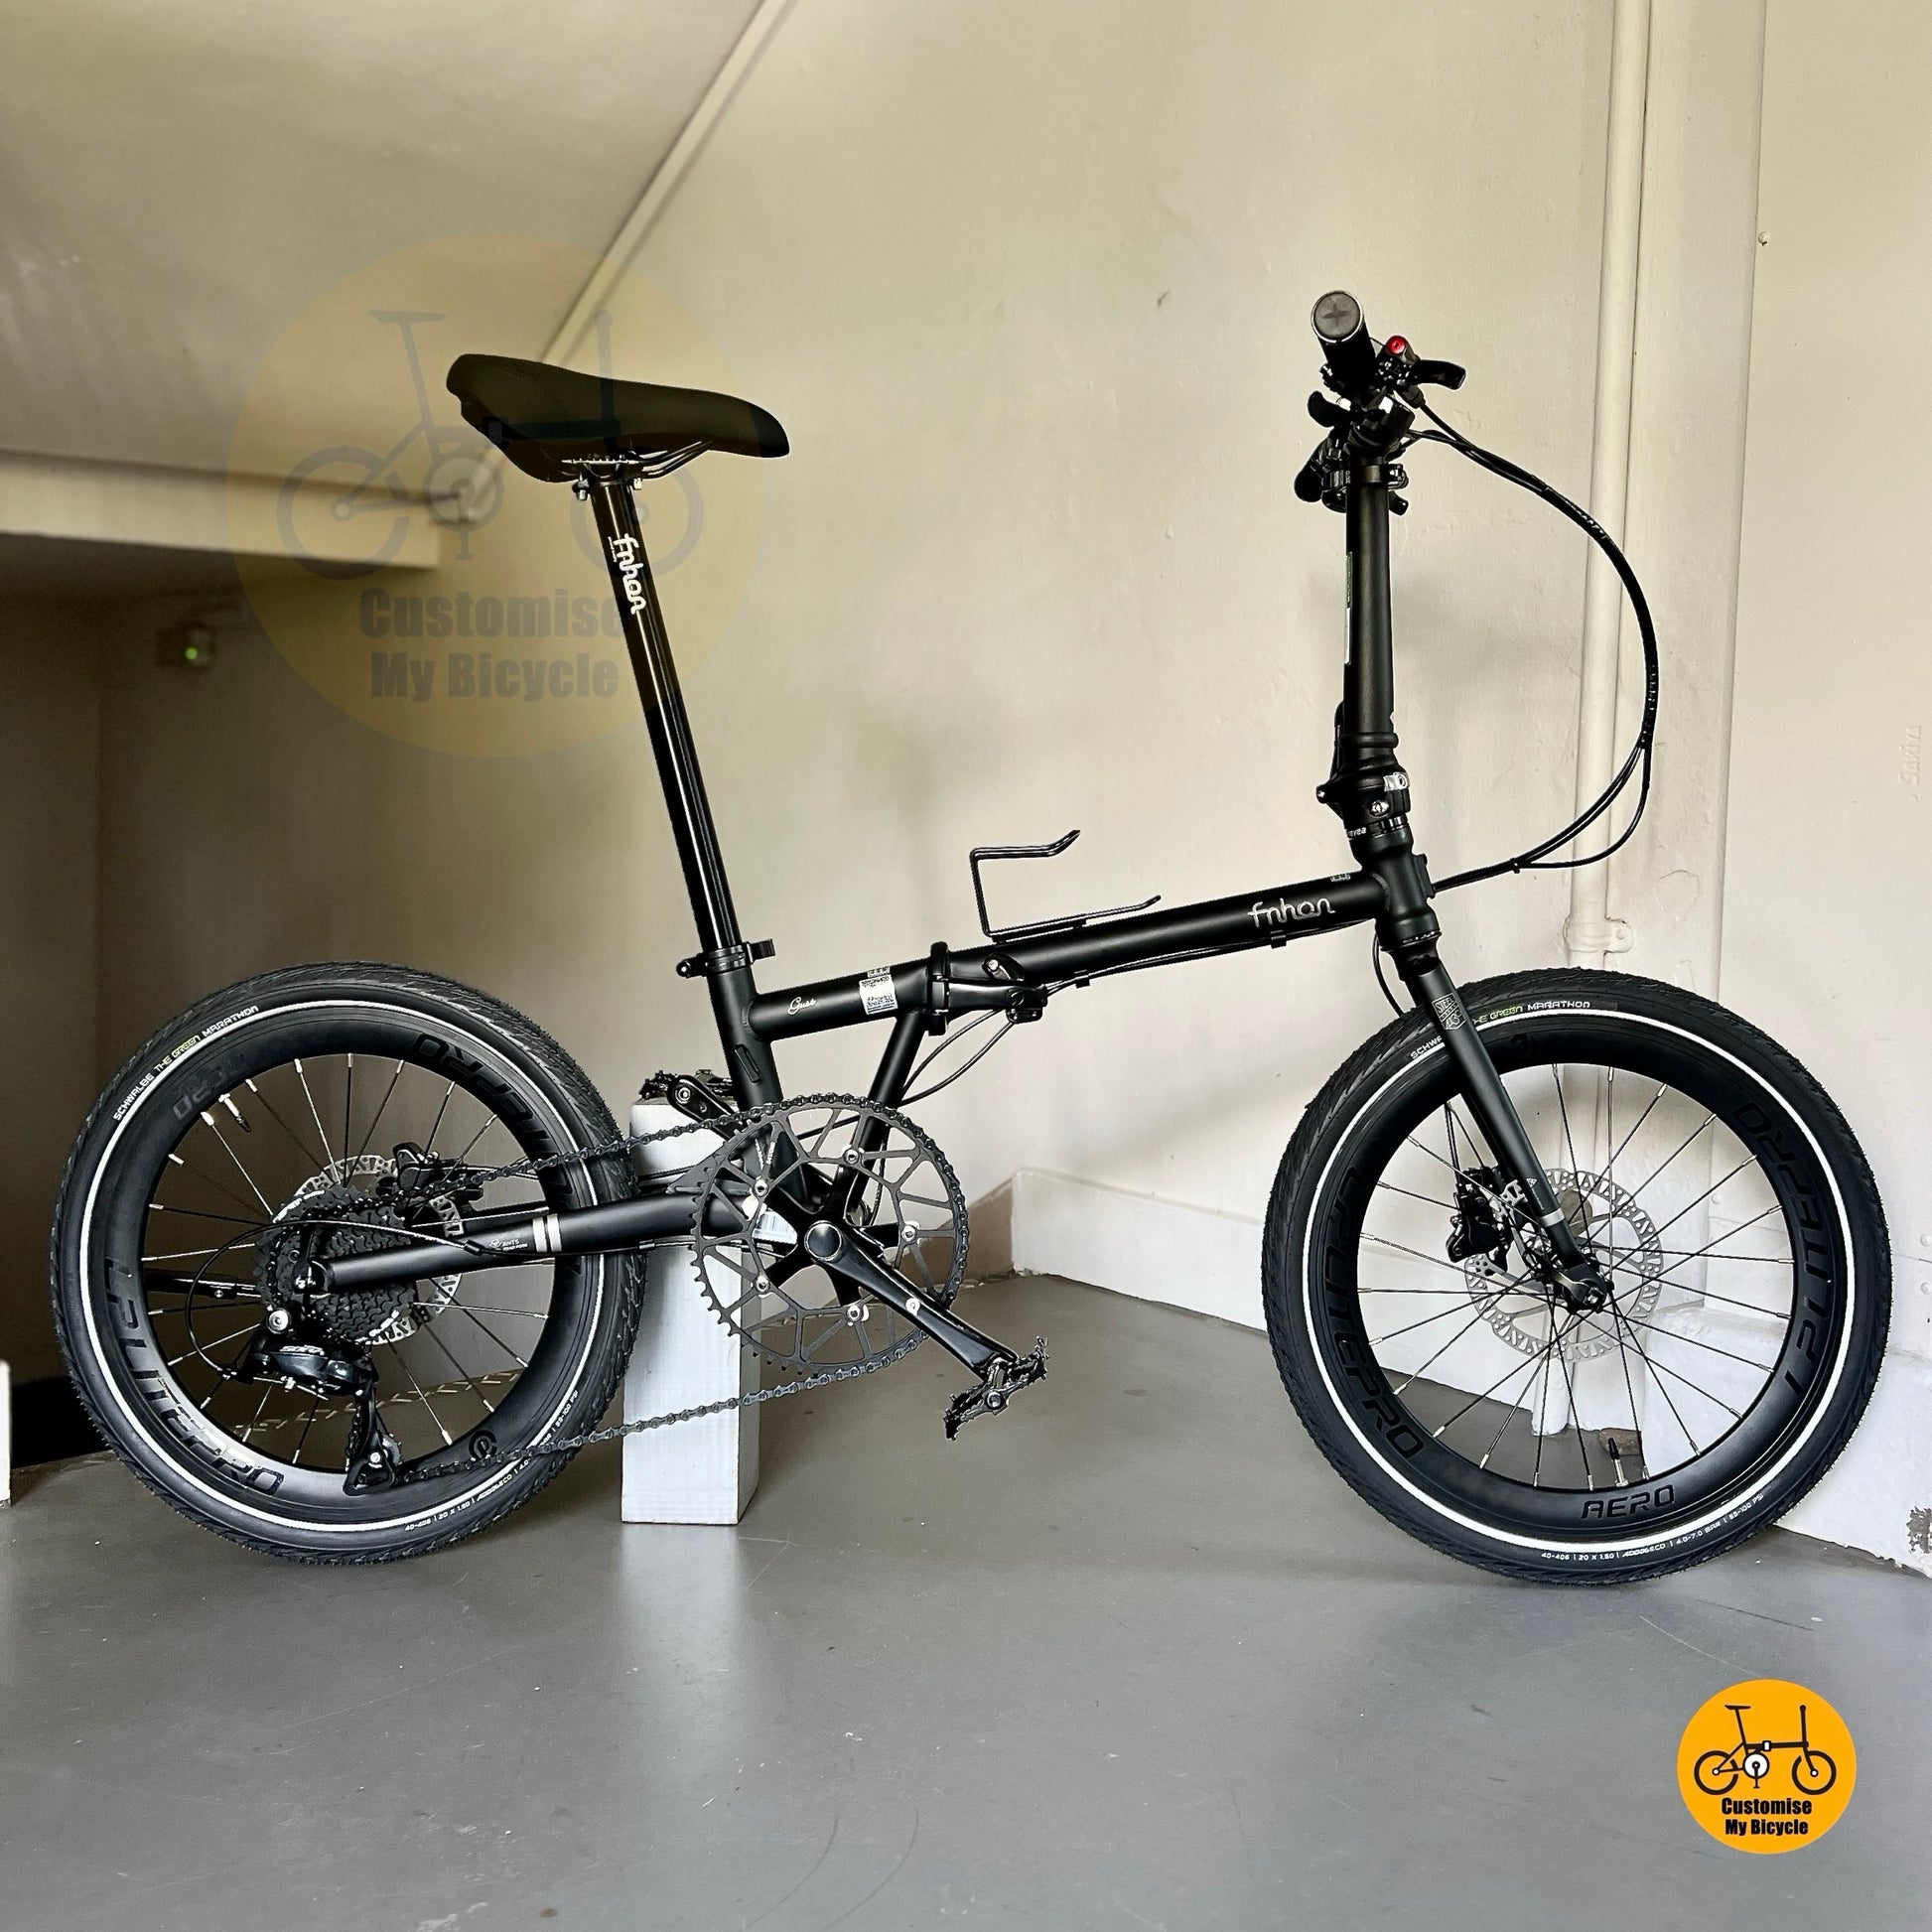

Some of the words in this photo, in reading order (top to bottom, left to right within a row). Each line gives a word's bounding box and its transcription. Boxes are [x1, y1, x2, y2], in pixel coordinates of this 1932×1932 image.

[613, 533, 647, 616] fnhon
[1247, 897, 1336, 928] fnhon
[1410, 1035, 1444, 1060] SCHWA
[1488, 1005, 1524, 1021] GREEN
[1527, 1000, 1591, 1012] MARATHON
[113, 1072, 155, 1121] SCHWALBE
[153, 1054, 173, 1073] THE
[201, 1005, 259, 1037] MARATHON
[1581, 1485, 1675, 1519] AERO
